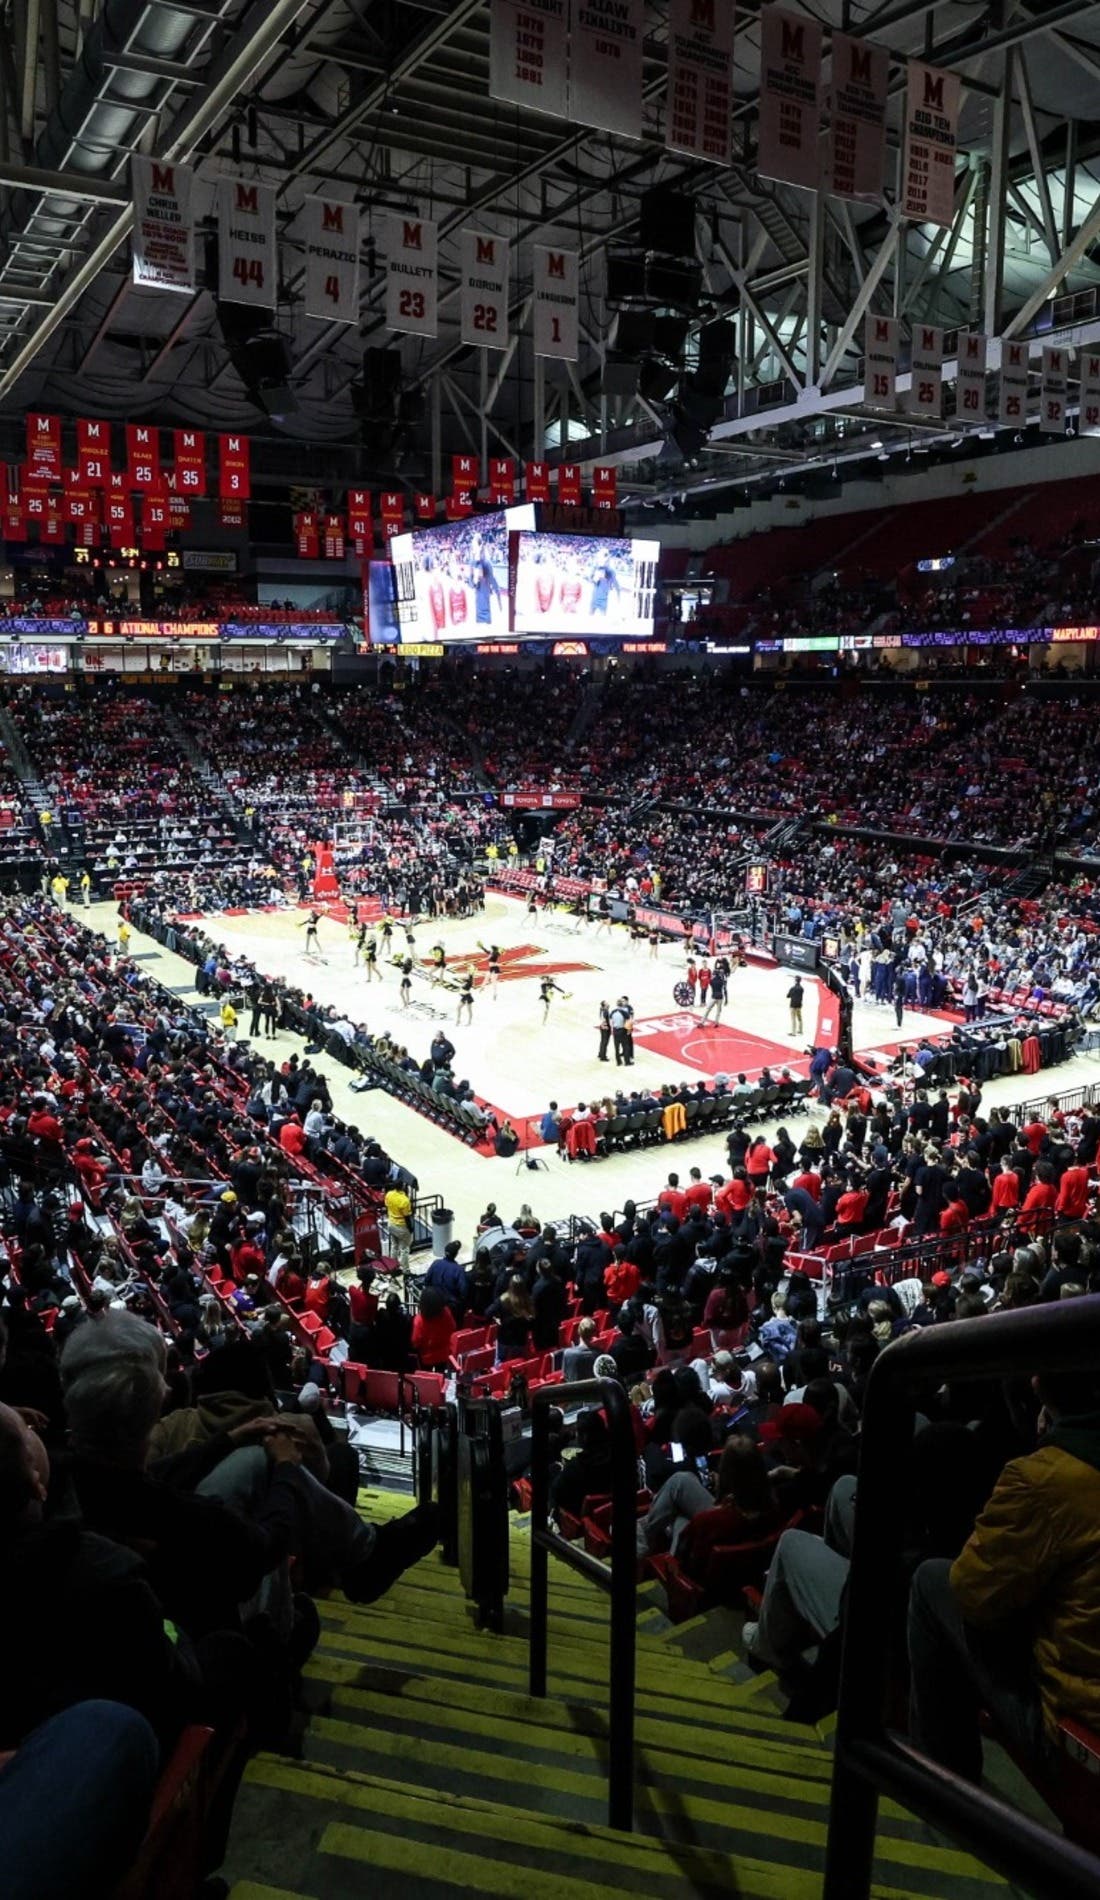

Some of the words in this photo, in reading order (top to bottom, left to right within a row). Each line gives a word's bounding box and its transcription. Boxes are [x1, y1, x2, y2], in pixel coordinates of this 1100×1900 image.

[579, 9, 636, 39] FINALISTS
[781, 19, 805, 64] M
[851, 45, 872, 87] M
[923, 71, 944, 112] M
[915, 109, 931, 125] BIG
[934, 114, 950, 131] TEN
[909, 121, 955, 146] CHAMPIONS
[151, 162, 175, 195] M
[235, 183, 258, 215] M
[146, 208, 182, 222] WELLER
[322, 203, 344, 234] M
[229, 228, 266, 245] HEISS
[403, 220, 422, 250] M
[476, 236, 495, 266] M
[233, 256, 264, 288] 44
[390, 261, 434, 279] BULLETT
[547, 252, 566, 280] M
[324, 275, 339, 303] 4
[468, 277, 502, 292] DORON
[399, 290, 425, 319] 23
[473, 304, 497, 332] 22
[552, 317, 561, 343] 1
[874, 374, 888, 396] 15
[918, 382, 934, 403] 25
[964, 390, 978, 410] 20
[1007, 396, 1020, 415] 25
[1048, 401, 1061, 420] 32
[1086, 406, 1098, 425] 42
[37, 418, 49, 432] M
[88, 423, 100, 437] M
[136, 428, 149, 443] M
[183, 433, 195, 447] M
[229, 438, 240, 452] M
[87, 461, 102, 478] 21
[461, 459, 470, 471] M
[533, 465, 542, 477] M
[112, 475, 122, 486] M
[136, 467, 152, 482] 25
[183, 470, 199, 485] 35
[565, 467, 574, 479] M
[601, 470, 609, 481] M
[231, 474, 239, 489] 3
[9, 494, 18, 505] M
[28, 499, 42, 513] 25
[48, 498, 56, 508] M
[70, 502, 84, 516] 52
[110, 505, 124, 519] 55
[151, 508, 163, 521] 15
[354, 521, 365, 534] 41
[387, 523, 399, 535] 54
[121, 547, 139, 558] 5:34
[163, 623, 218, 635] CHAMPIONS
[1052, 628, 1097, 641] MARYLAND
[399, 645, 417, 655] LEDO
[420, 645, 443, 655] PIZZA
